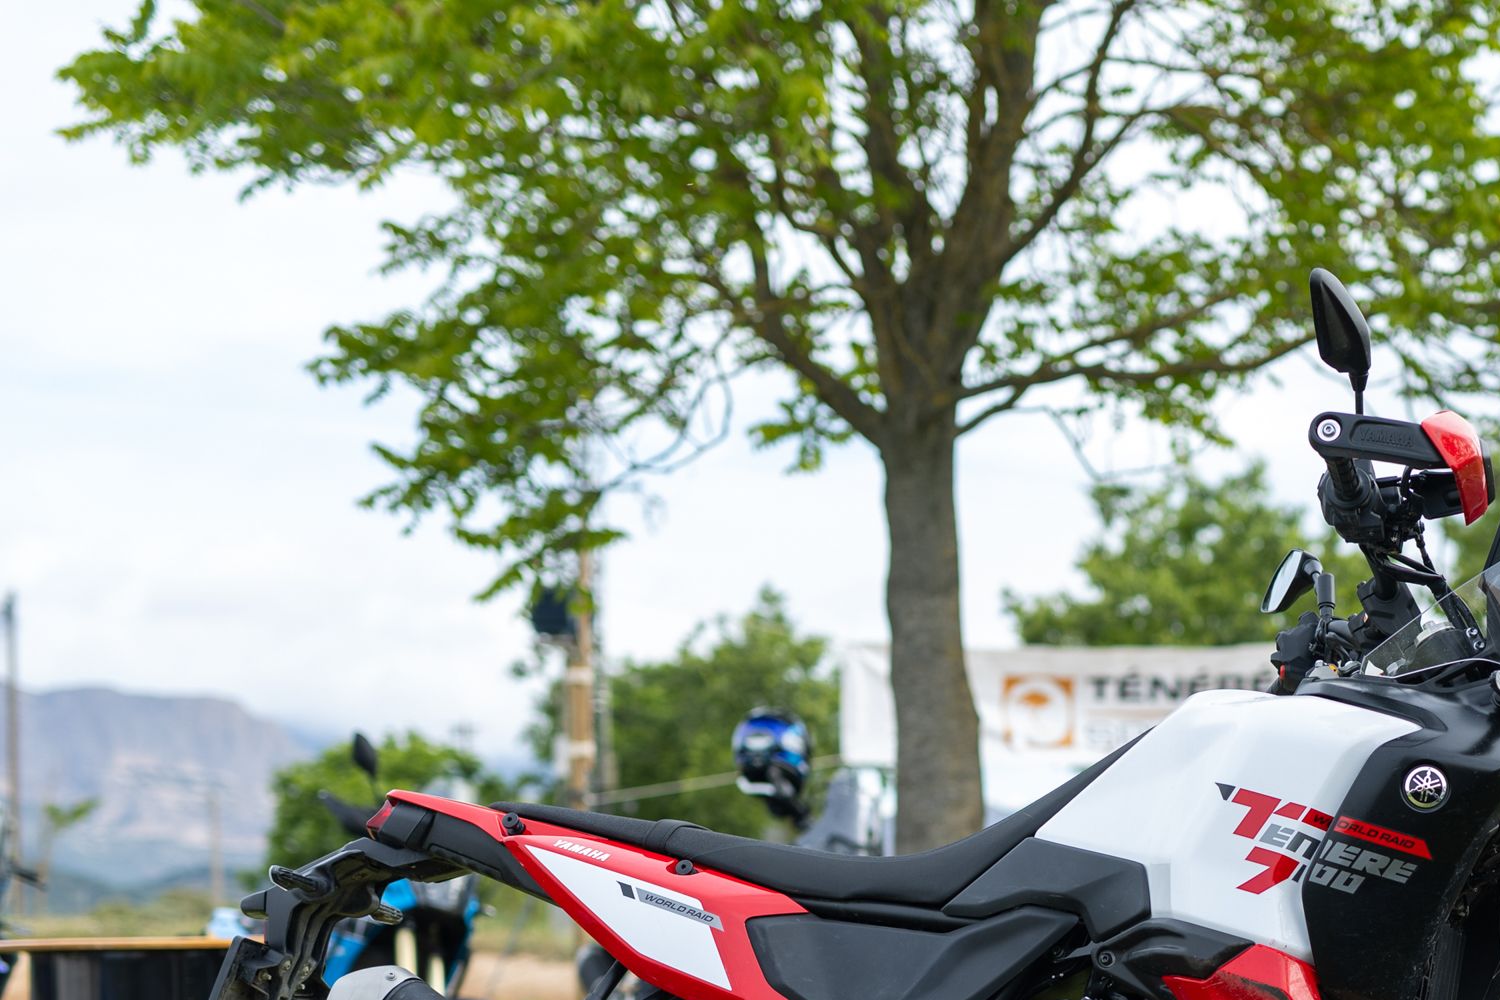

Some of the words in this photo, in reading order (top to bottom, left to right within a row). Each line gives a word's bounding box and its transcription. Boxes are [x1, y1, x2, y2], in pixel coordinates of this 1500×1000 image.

[553, 839, 612, 862] YAMAHA
[1379, 830, 1415, 849] RAID
[644, 893, 686, 913] WORLD
[686, 908, 714, 923] RAID
